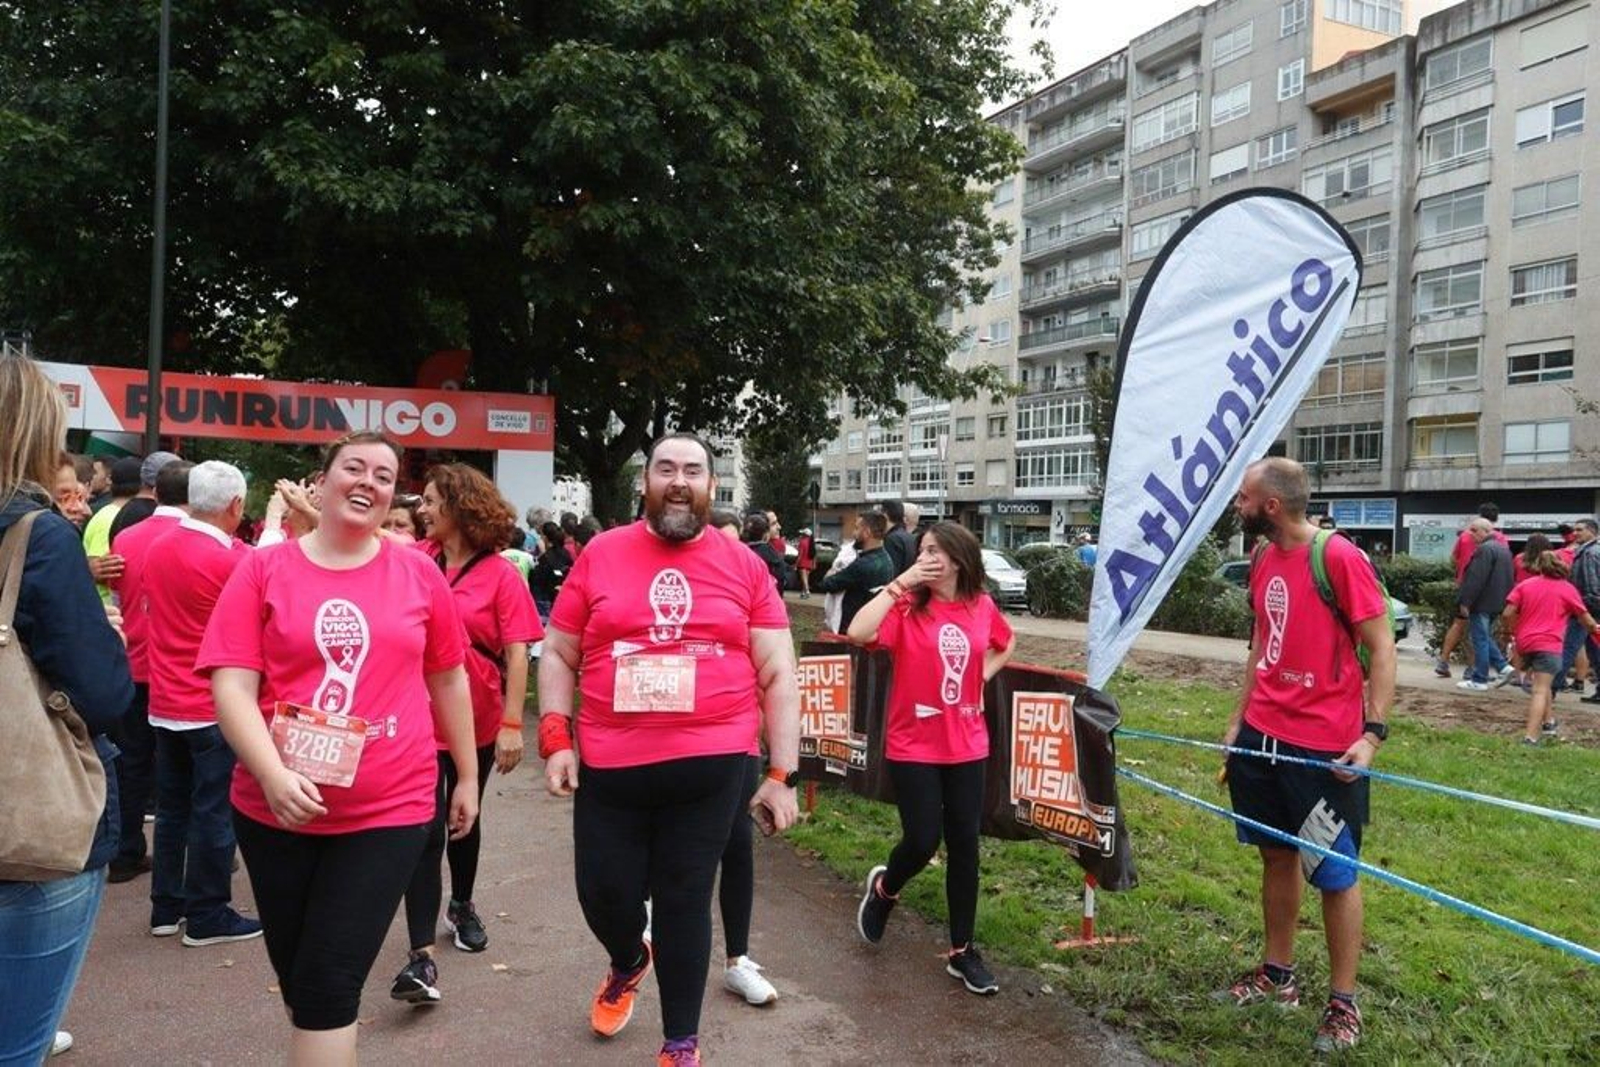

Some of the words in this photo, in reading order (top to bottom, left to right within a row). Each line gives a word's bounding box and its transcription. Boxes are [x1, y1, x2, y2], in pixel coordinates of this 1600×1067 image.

[1105, 258, 1334, 627] Atlántico
[997, 503, 1040, 514] farmacia
[322, 622, 360, 632] VIGO
[632, 673, 679, 694] 2549
[797, 663, 845, 687] SAVE
[284, 726, 344, 765] 3286
[1018, 734, 1063, 768] THE
